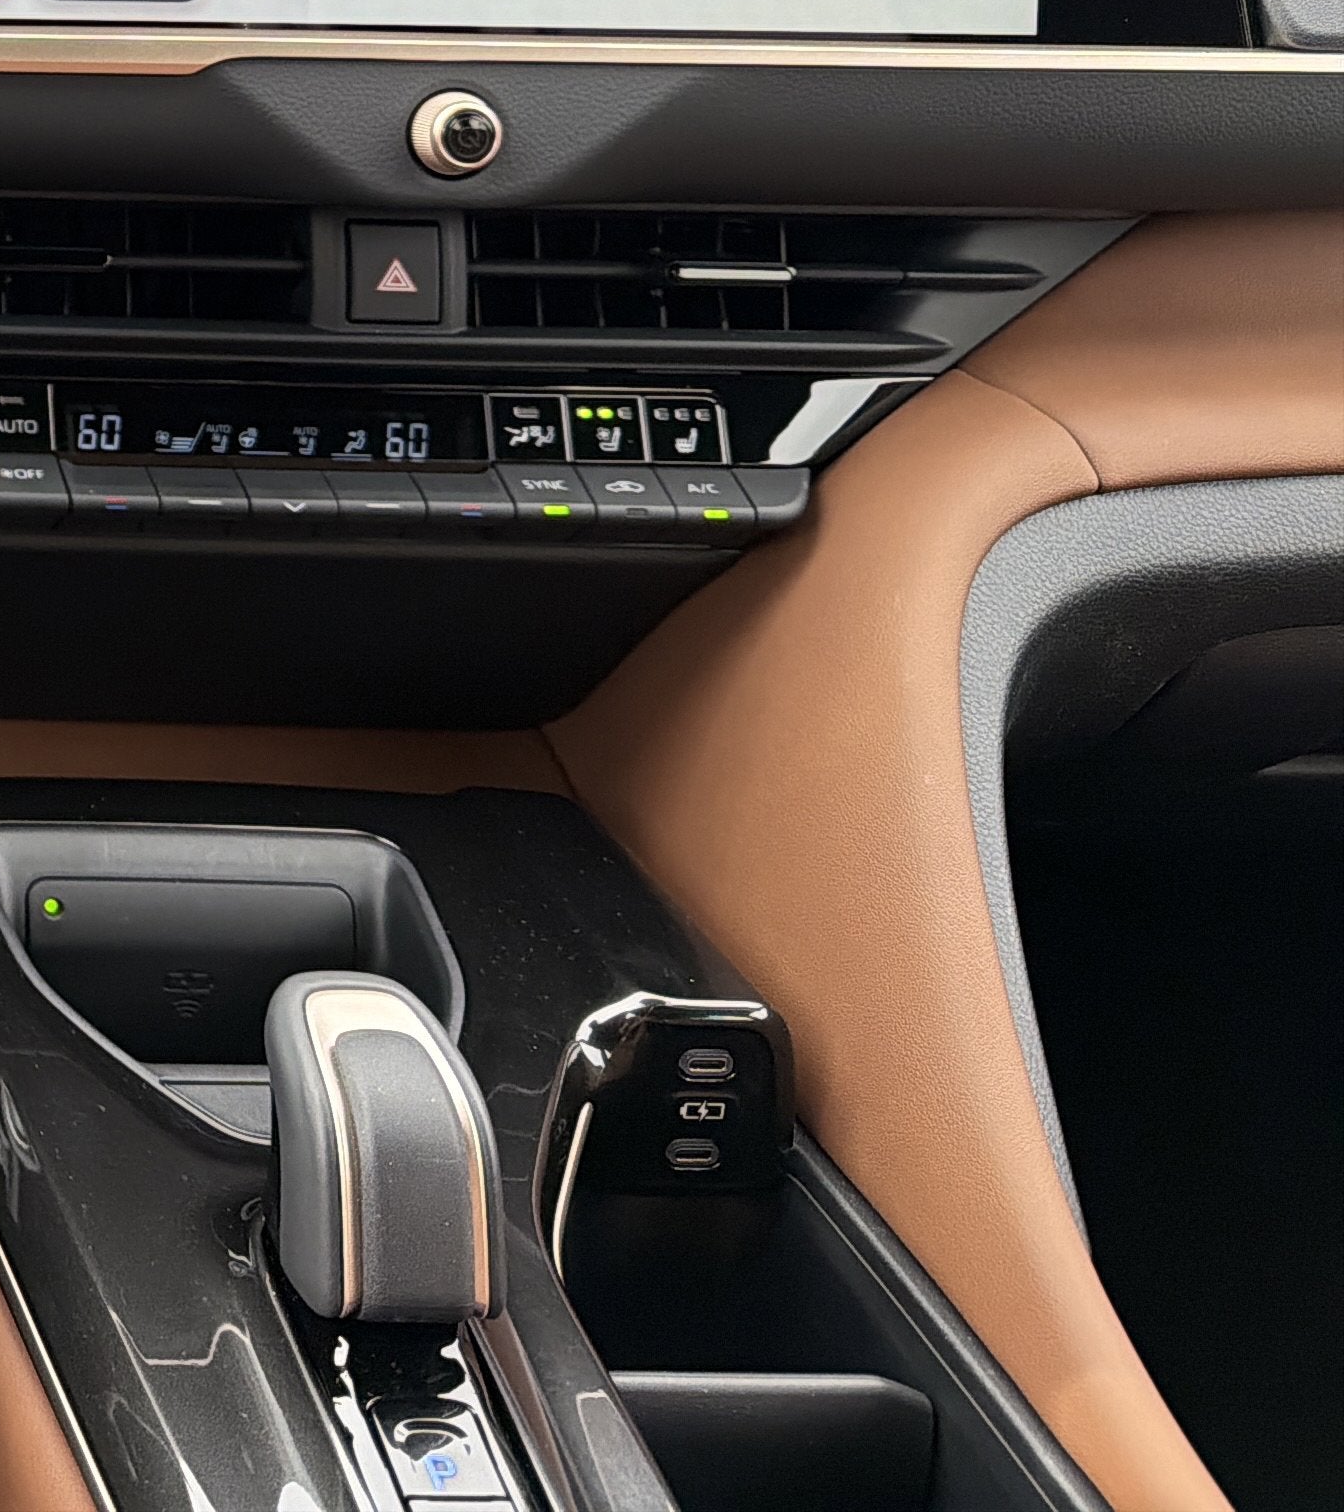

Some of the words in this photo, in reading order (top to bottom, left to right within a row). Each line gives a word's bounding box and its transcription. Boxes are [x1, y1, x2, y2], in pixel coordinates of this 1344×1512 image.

[77, 414, 123, 451] 60
[206, 424, 232, 434] AUTO
[293, 426, 319, 436] AUTO
[385, 422, 430, 462] 60
[13, 469, 45, 480] OFF
[521, 479, 568, 492] SYNC
[687, 483, 720, 494] A/C
[424, 1456, 458, 1490] P
